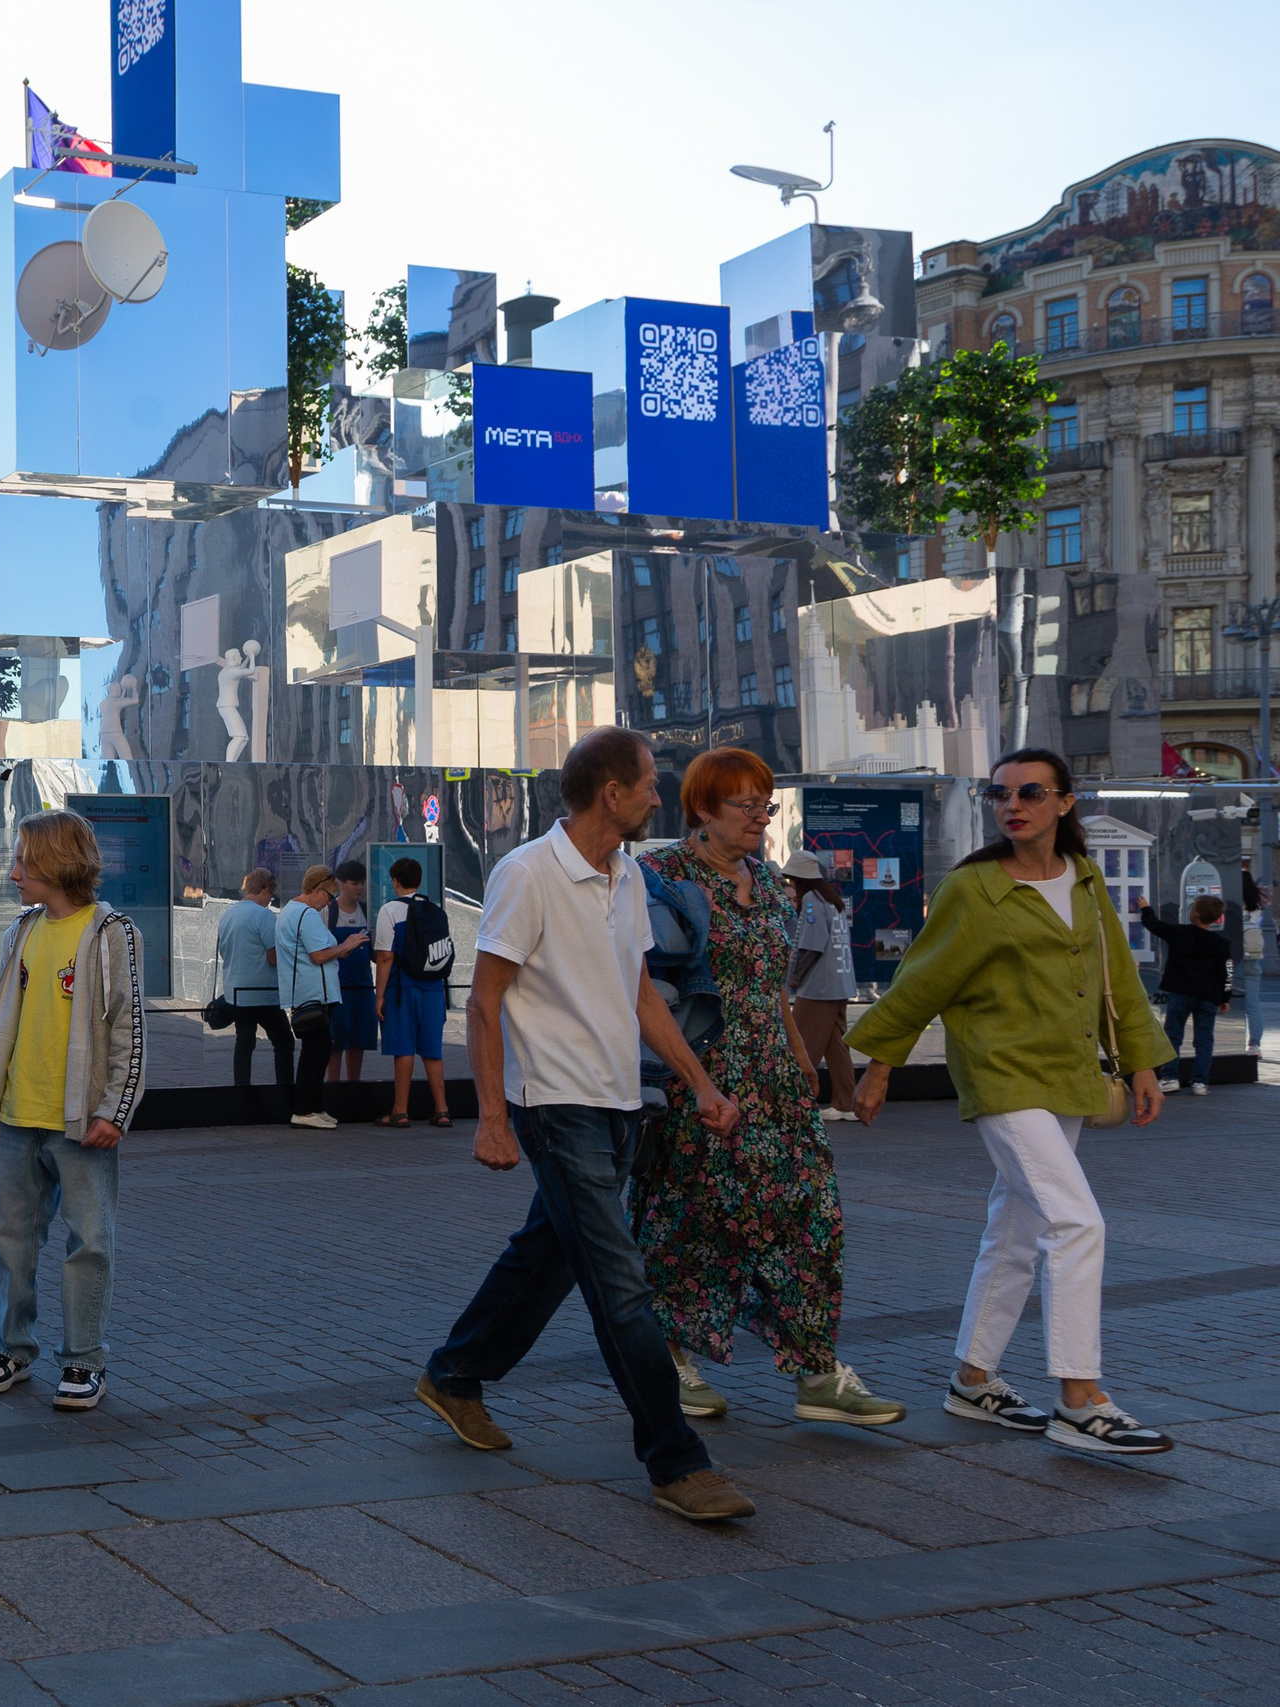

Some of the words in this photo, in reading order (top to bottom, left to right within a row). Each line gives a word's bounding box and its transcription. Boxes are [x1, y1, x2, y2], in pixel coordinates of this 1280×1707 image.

[485, 427, 553, 449] МЕТА
[554, 431, 583, 444] ВДНХ
[979, 1395, 1002, 1414] N
[1085, 1418, 1114, 1438] N
